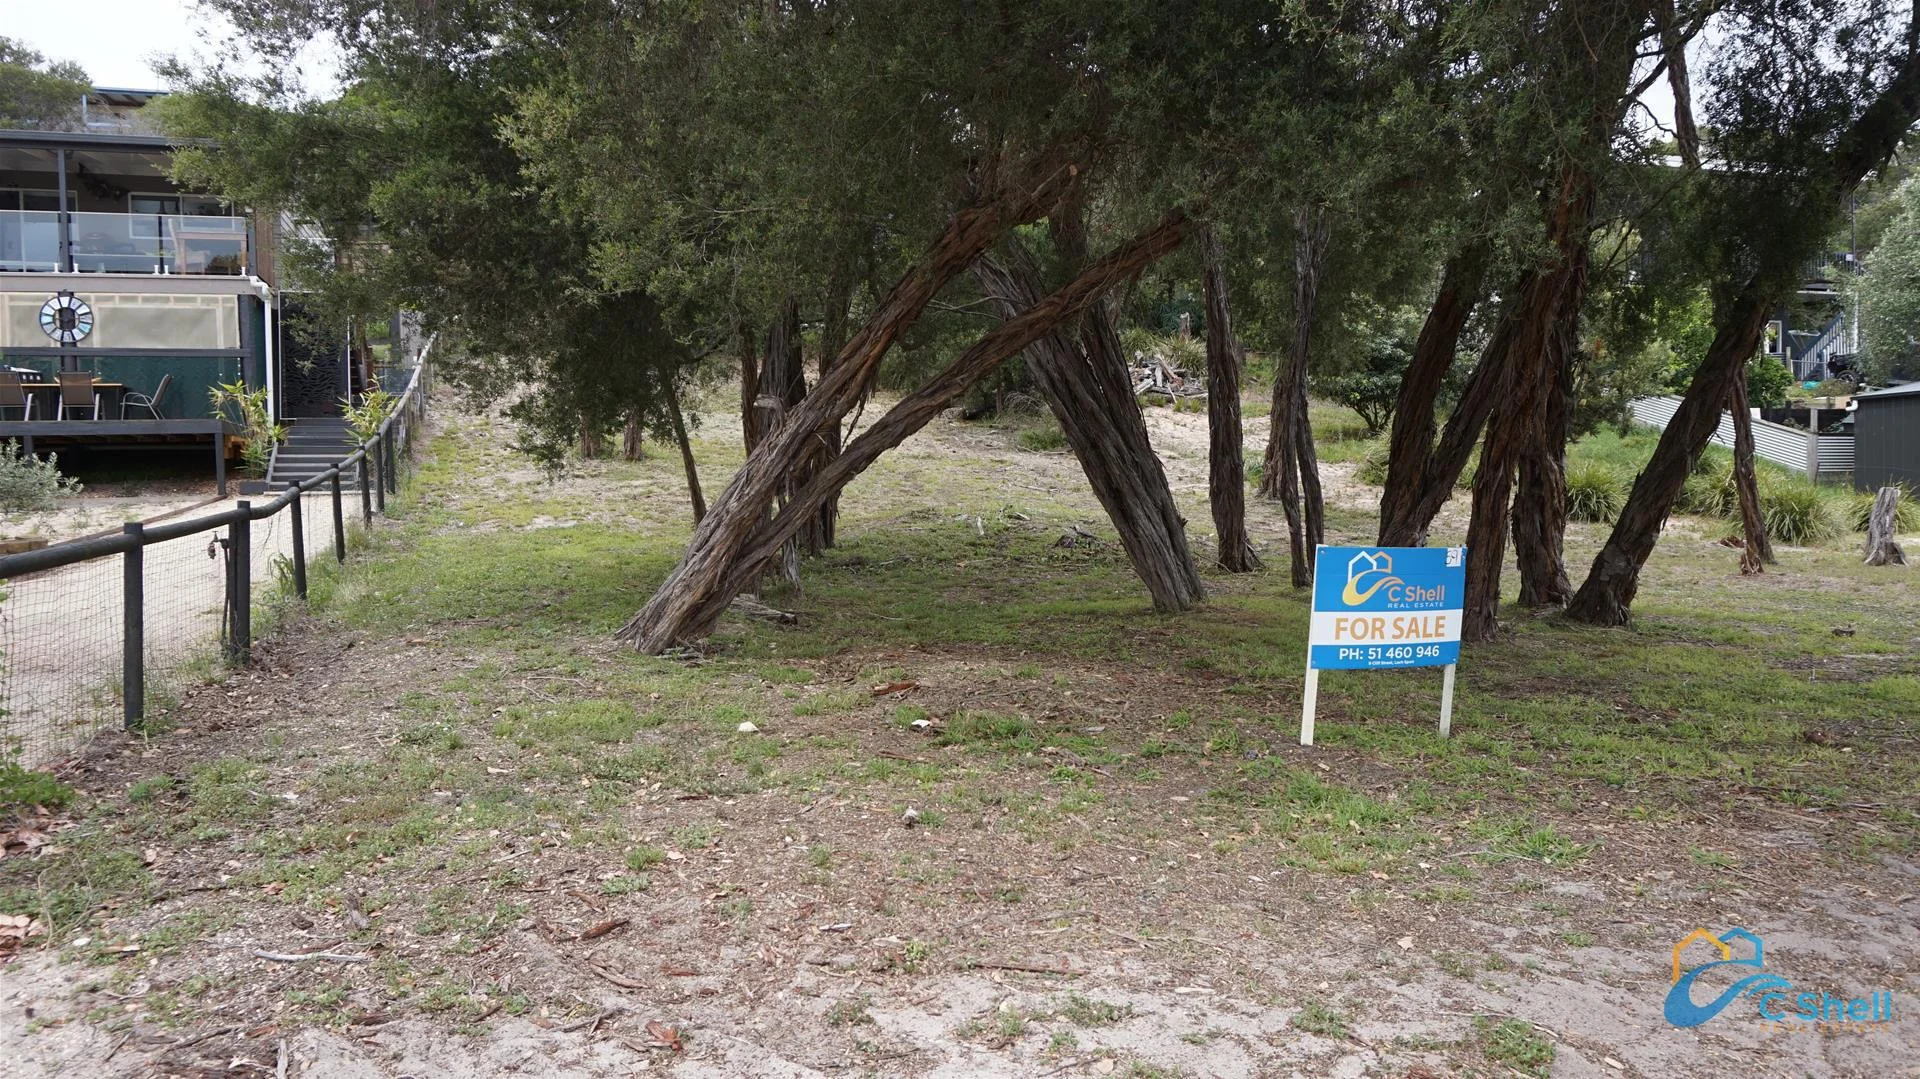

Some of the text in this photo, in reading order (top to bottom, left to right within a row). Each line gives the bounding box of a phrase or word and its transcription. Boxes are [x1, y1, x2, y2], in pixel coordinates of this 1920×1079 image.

[1388, 585, 1445, 602] C Shell
[1334, 615, 1446, 641] FOR SALE
[1339, 645, 1440, 660] PH: 51 460 946
